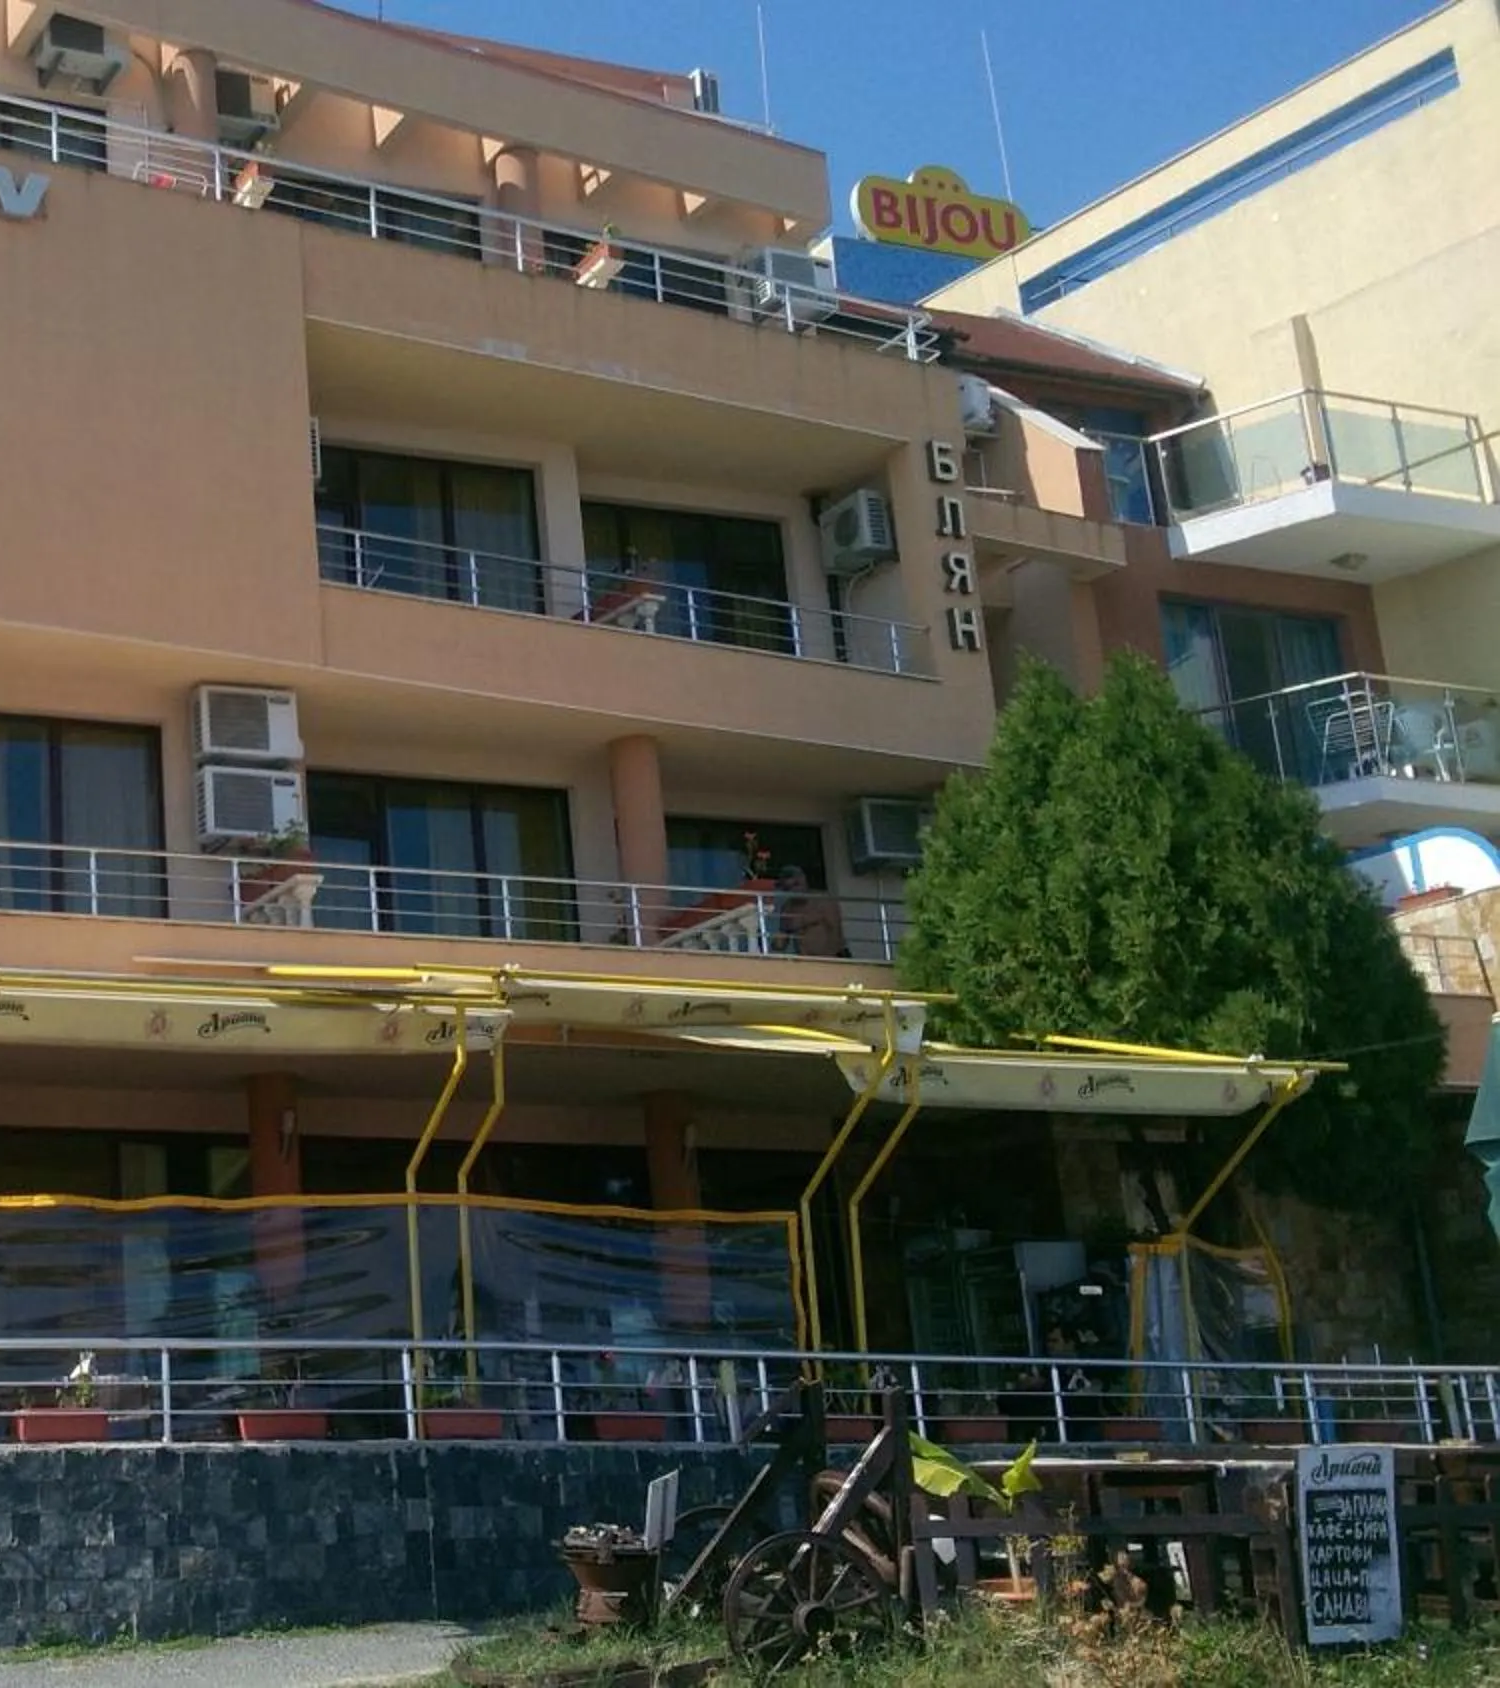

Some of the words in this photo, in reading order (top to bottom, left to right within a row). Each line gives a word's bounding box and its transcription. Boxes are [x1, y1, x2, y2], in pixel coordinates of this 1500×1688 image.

[871, 187, 1016, 251] BIJOU
[927, 439, 981, 652] БЛЯН
[1311, 1453, 1383, 1484] Ариана
